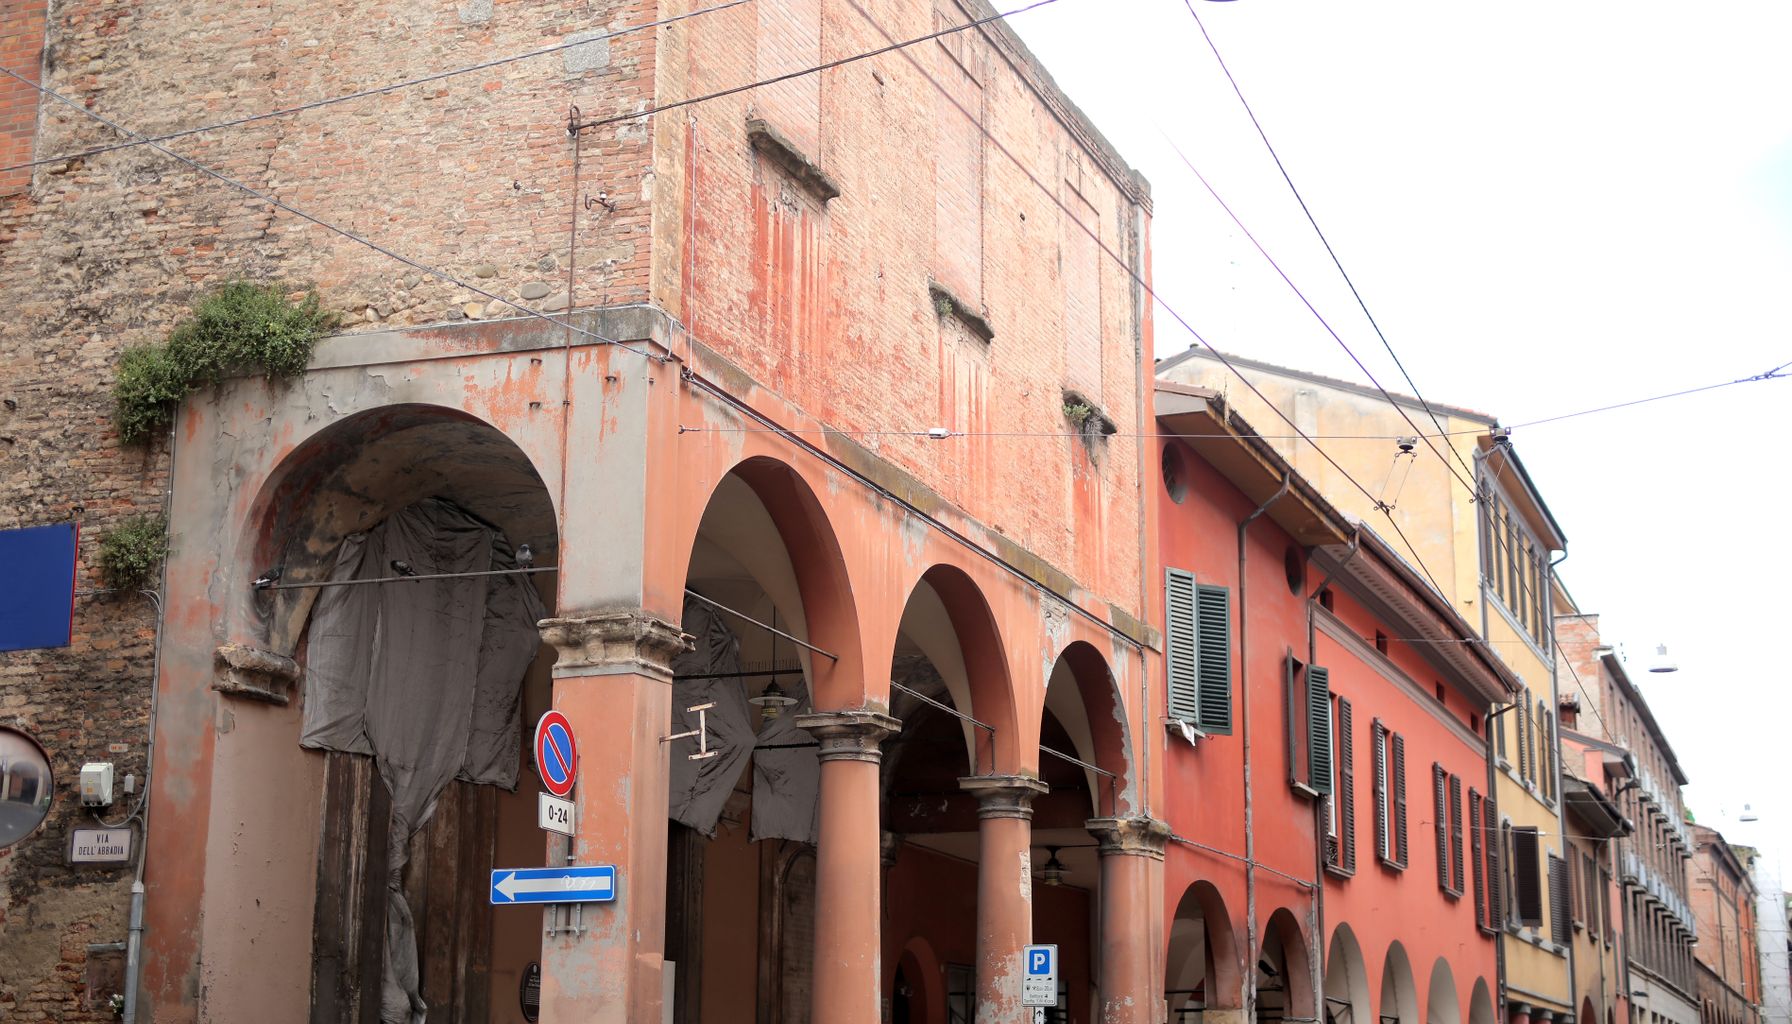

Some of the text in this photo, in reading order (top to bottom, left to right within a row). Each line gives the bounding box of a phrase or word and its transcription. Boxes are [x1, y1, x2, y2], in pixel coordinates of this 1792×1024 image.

[548, 804, 568, 824] 0-24
[96, 834, 109, 844] VIA
[1033, 953, 1046, 971] P
